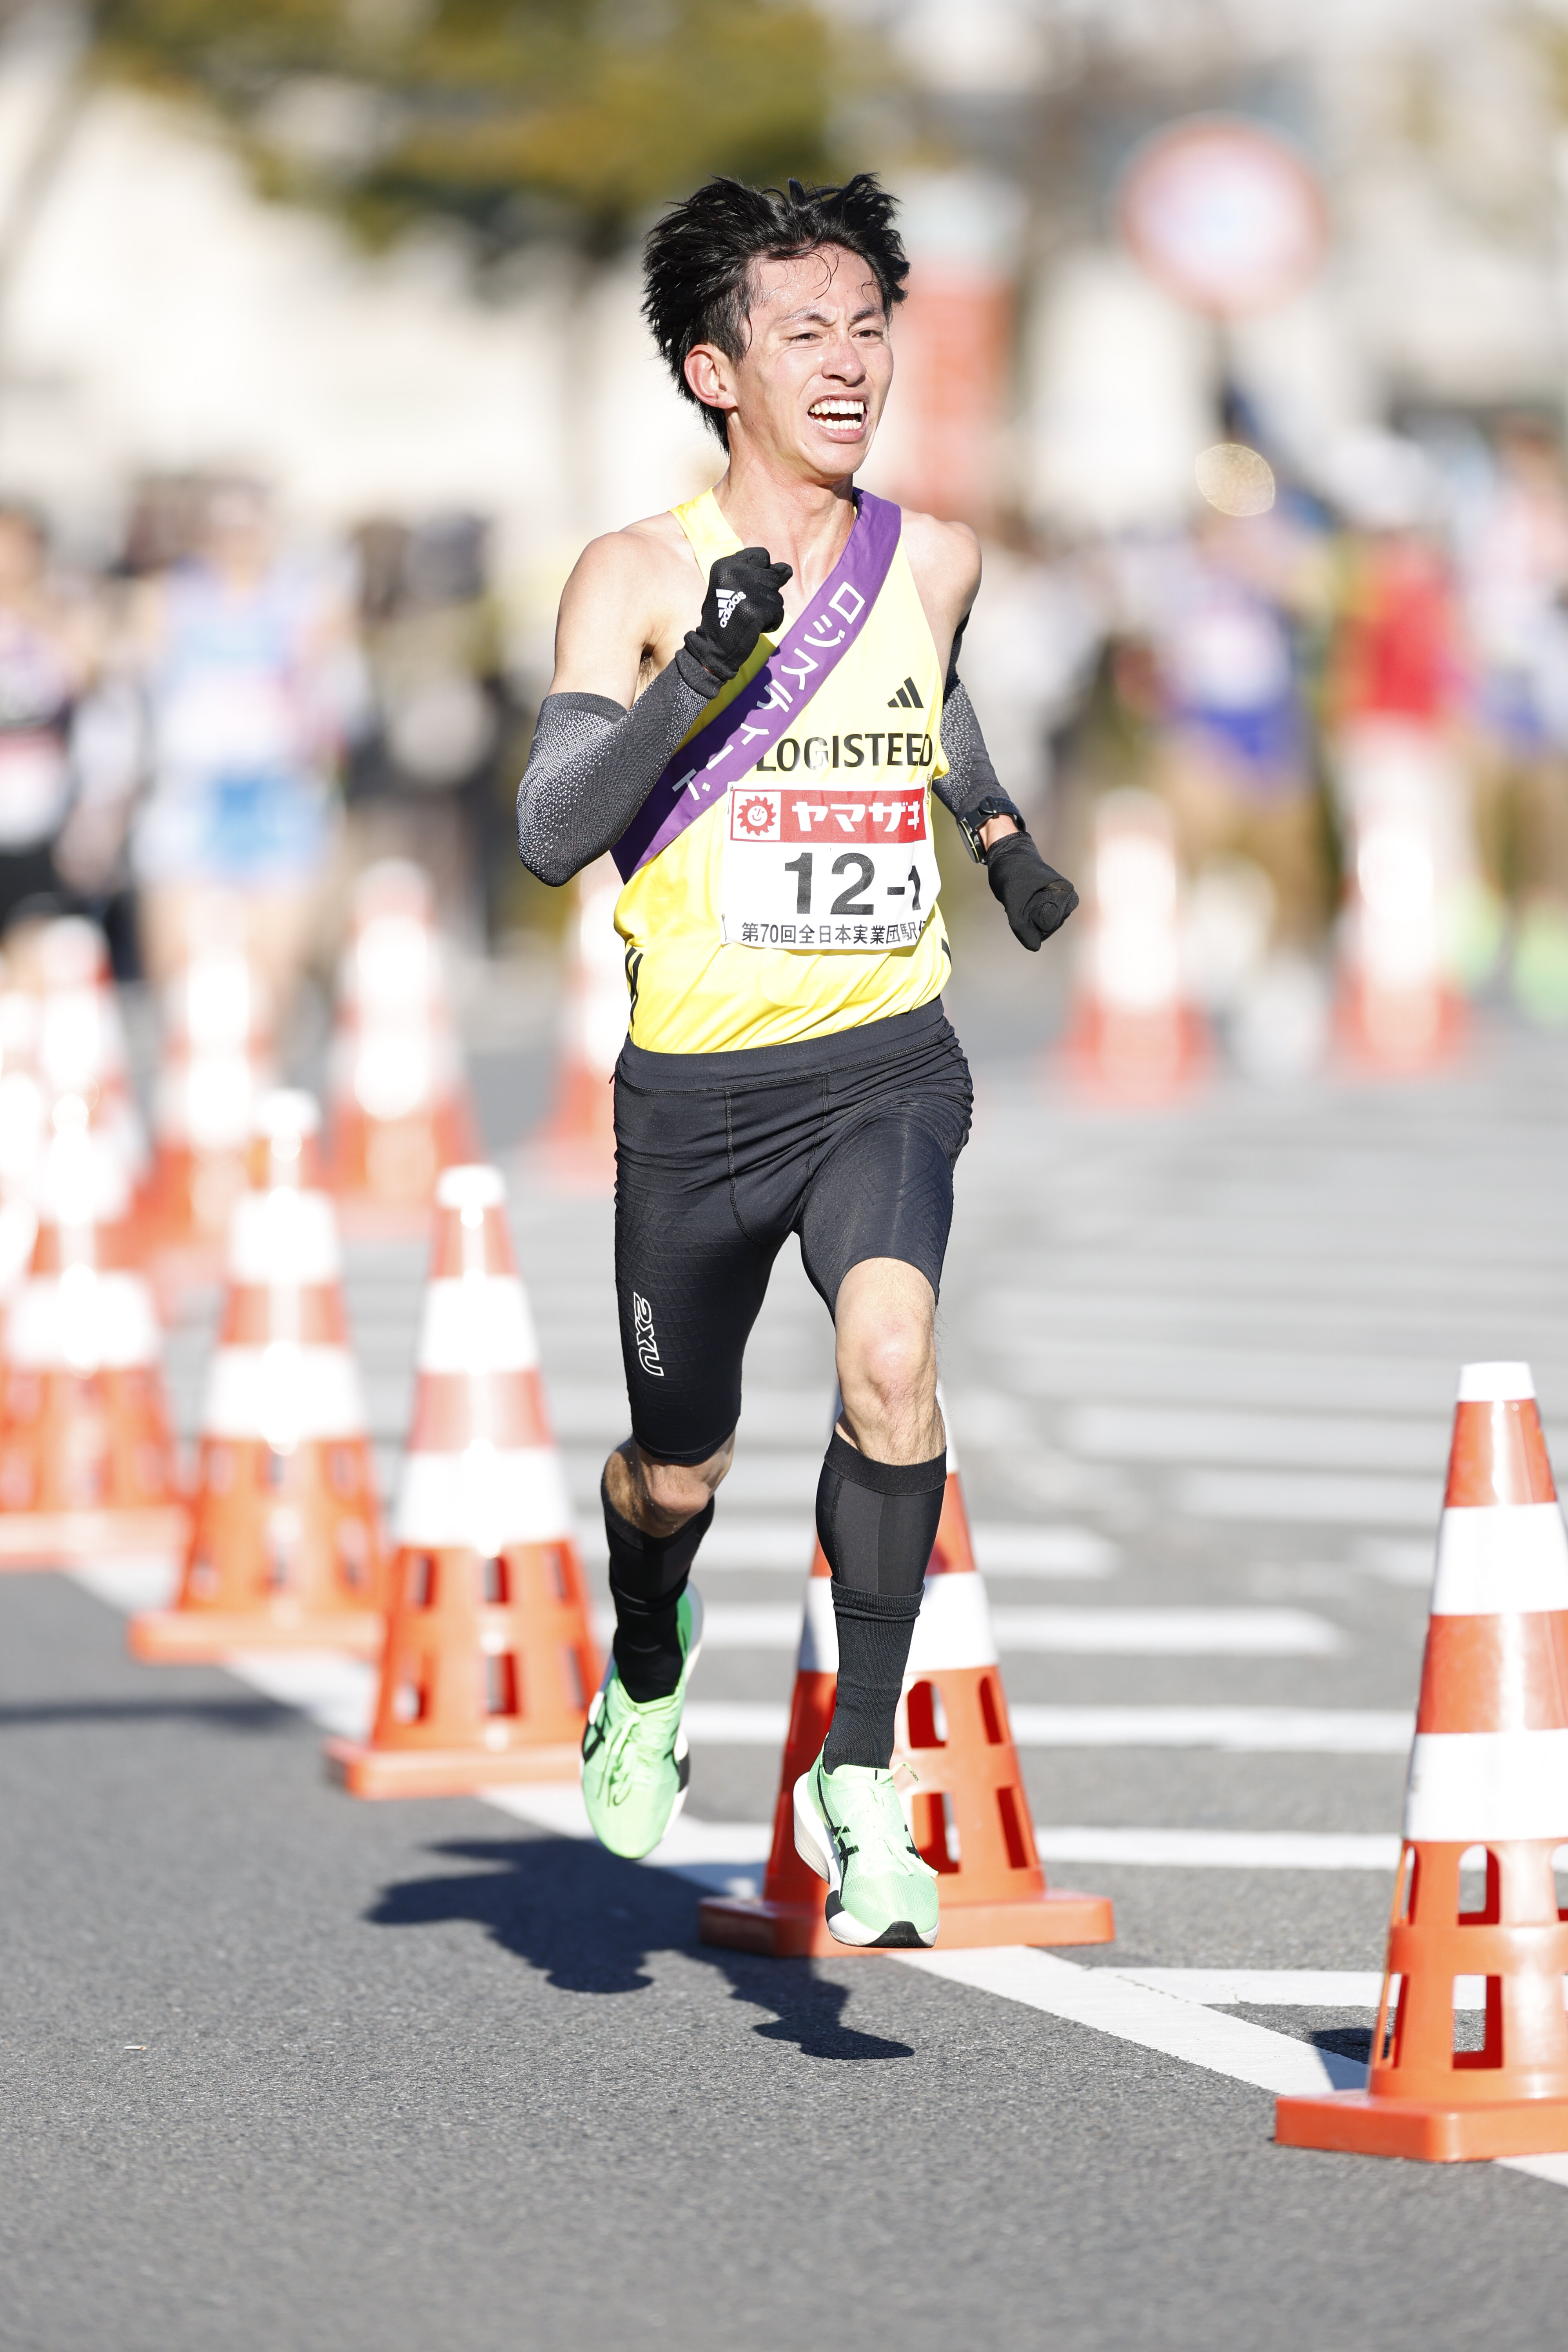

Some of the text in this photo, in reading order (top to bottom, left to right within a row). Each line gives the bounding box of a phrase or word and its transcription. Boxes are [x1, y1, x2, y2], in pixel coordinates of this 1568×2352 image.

[720, 591, 746, 628] adidas
[672, 581, 865, 800] ロジスティード
[756, 733, 933, 771] LOGISTEED
[633, 1292, 664, 1376] 2XU
